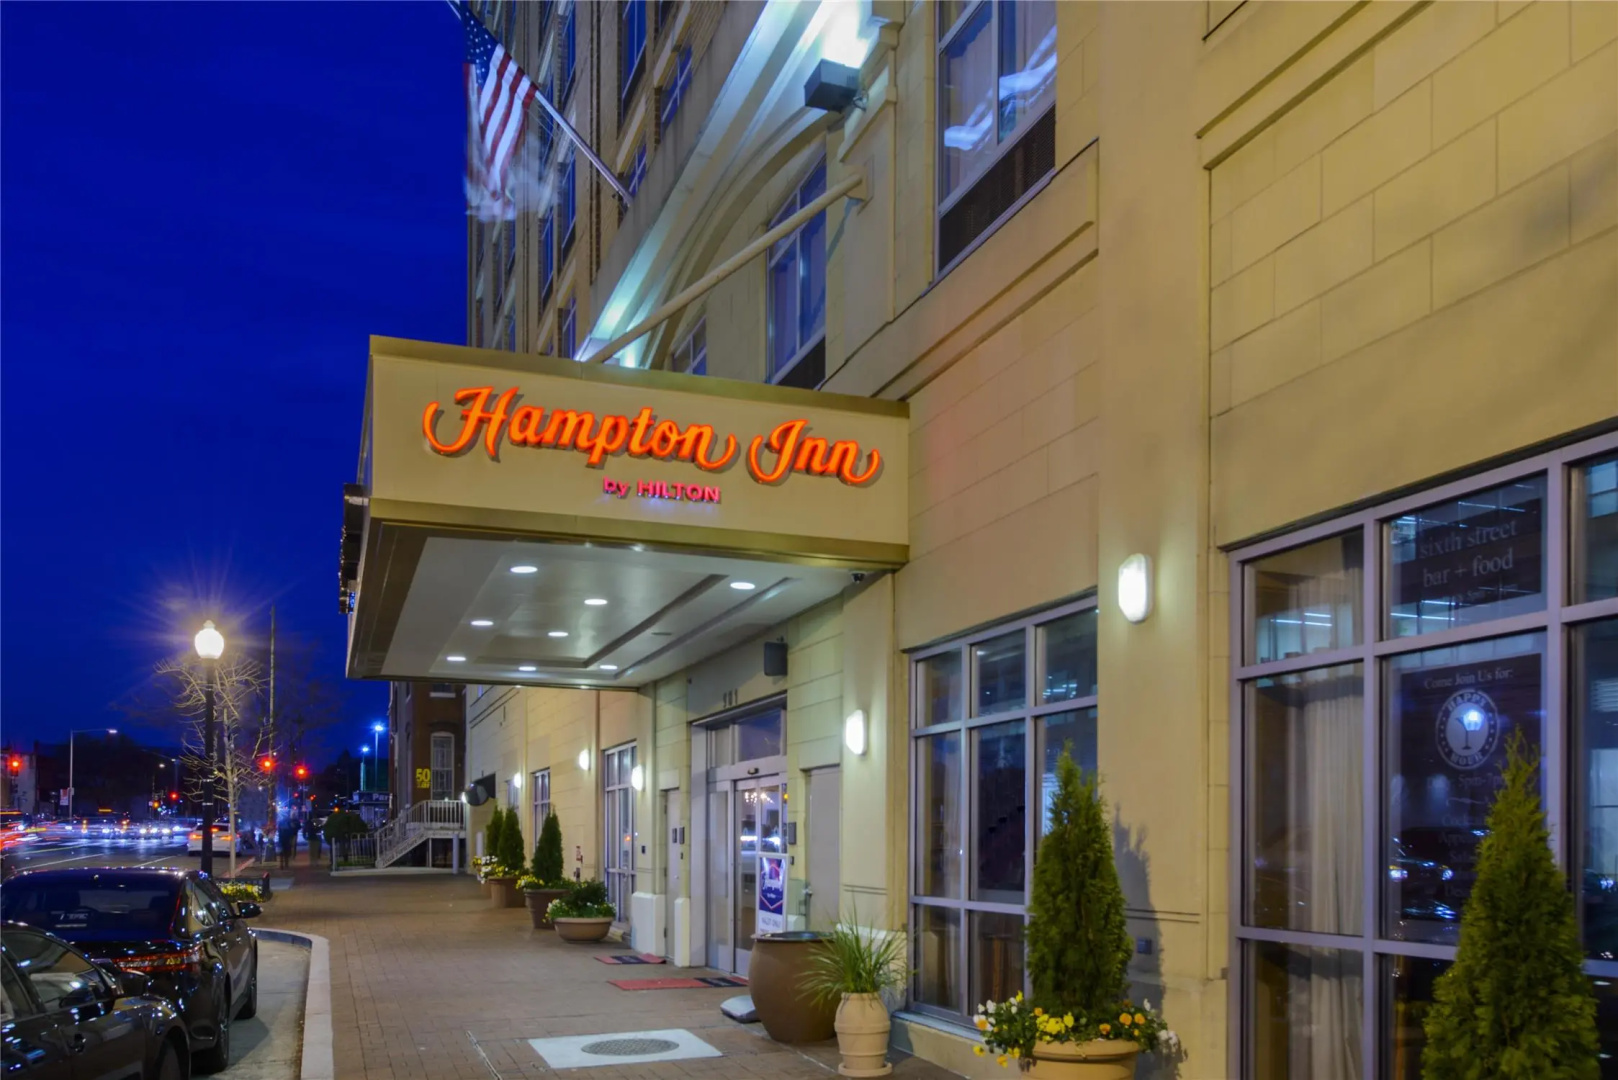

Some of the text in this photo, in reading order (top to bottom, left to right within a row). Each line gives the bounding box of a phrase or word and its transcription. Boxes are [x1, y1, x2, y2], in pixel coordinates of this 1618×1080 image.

[422, 385, 881, 484] Hampton Inn
[603, 475, 721, 504] by HILTON
[1419, 520, 1517, 558] sixth street
[1423, 567, 1450, 587] bar
[1472, 547, 1513, 577] food
[1424, 676, 1453, 690] Come
[1455, 673, 1475, 686] Join
[1478, 670, 1492, 682] Us
[1446, 692, 1487, 712] HAPPY
[1450, 751, 1483, 765] HOUR
